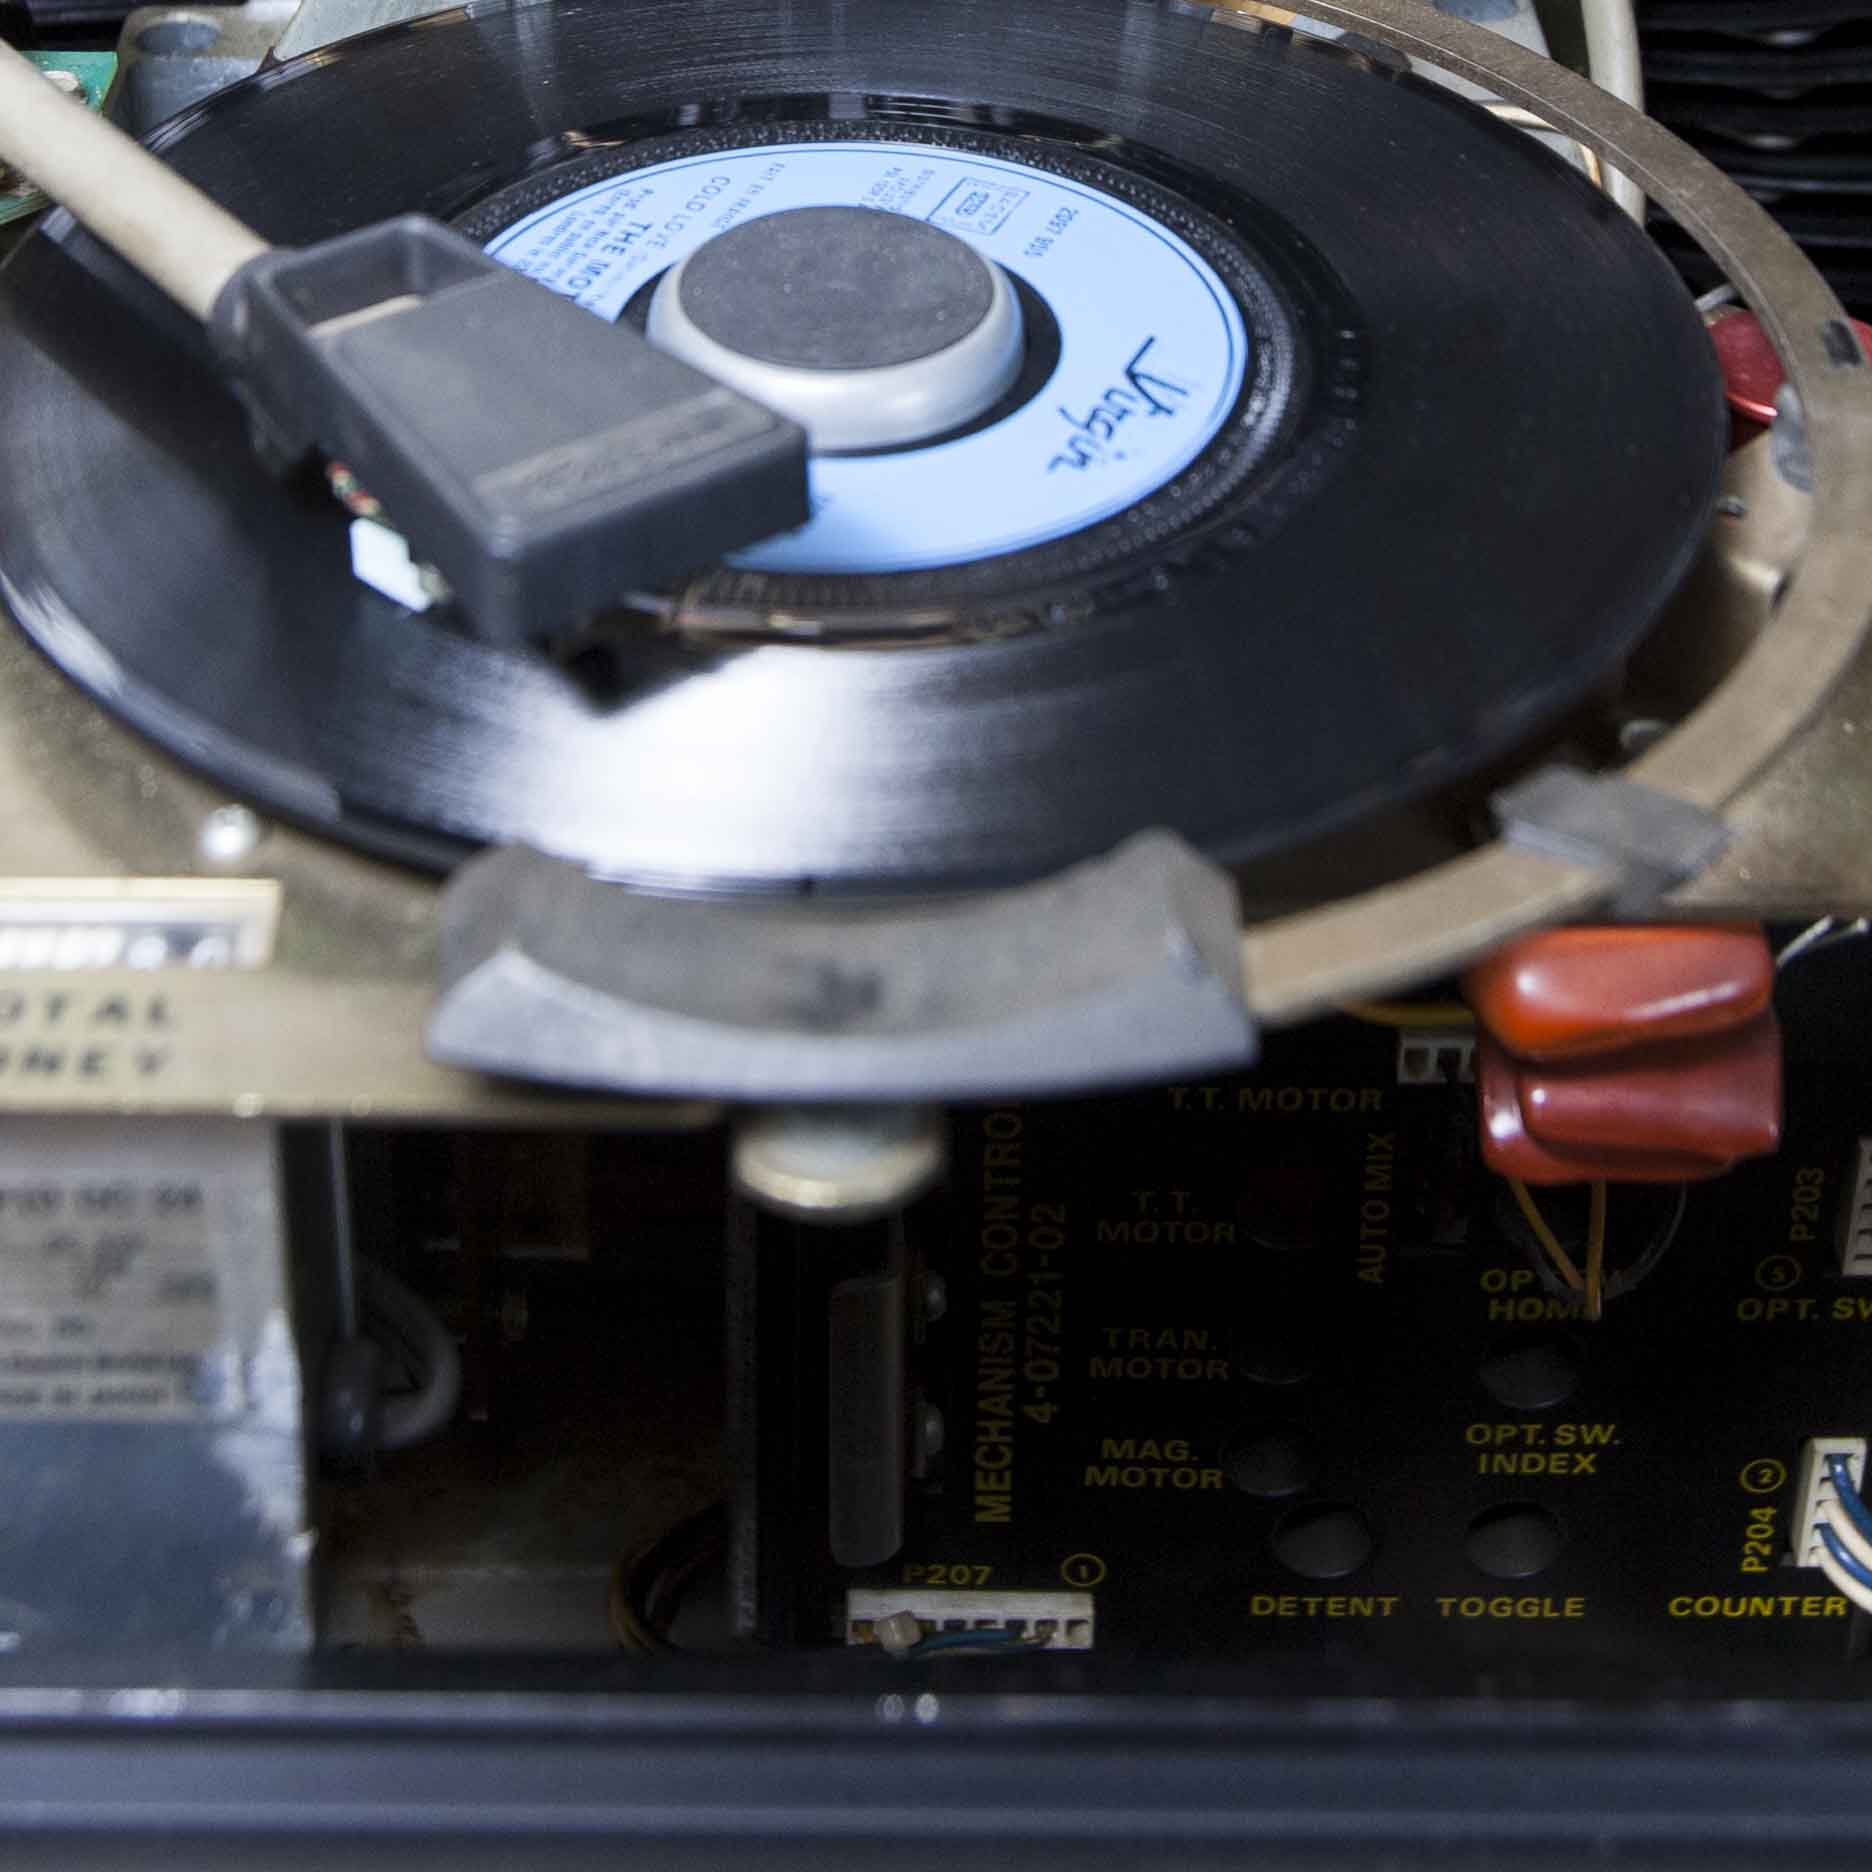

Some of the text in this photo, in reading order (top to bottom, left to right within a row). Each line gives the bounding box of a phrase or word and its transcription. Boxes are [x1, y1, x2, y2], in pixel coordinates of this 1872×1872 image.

[685, 175, 732, 212] COLD
[602, 219, 654, 258] THE
[1048, 337, 1189, 471] Virgin
[1239, 1088, 1385, 1112] MOTOR
[1356, 1131, 1395, 1286] AUTO MIX
[1791, 1168, 1824, 1240] P203
[1095, 1218, 1237, 1245] MOTOR
[1025, 1200, 1066, 1425] 4-07221-02
[1734, 1296, 1821, 1322] OPT.
[1101, 1327, 1217, 1354] TRAN.
[1088, 1357, 1233, 1382] MOTOR
[974, 1297, 1017, 1525] MECHANISM
[1101, 1439, 1201, 1462] MAG.
[1477, 1451, 1599, 1475] INDEX
[1083, 1466, 1226, 1489] MOTOR
[1739, 1504, 1777, 1574] P204
[903, 1564, 994, 1586] P207
[1248, 1593, 1401, 1618] DETENT
[1436, 1593, 1585, 1618] TOGGLE
[1667, 1593, 1849, 1618] COUNTER
